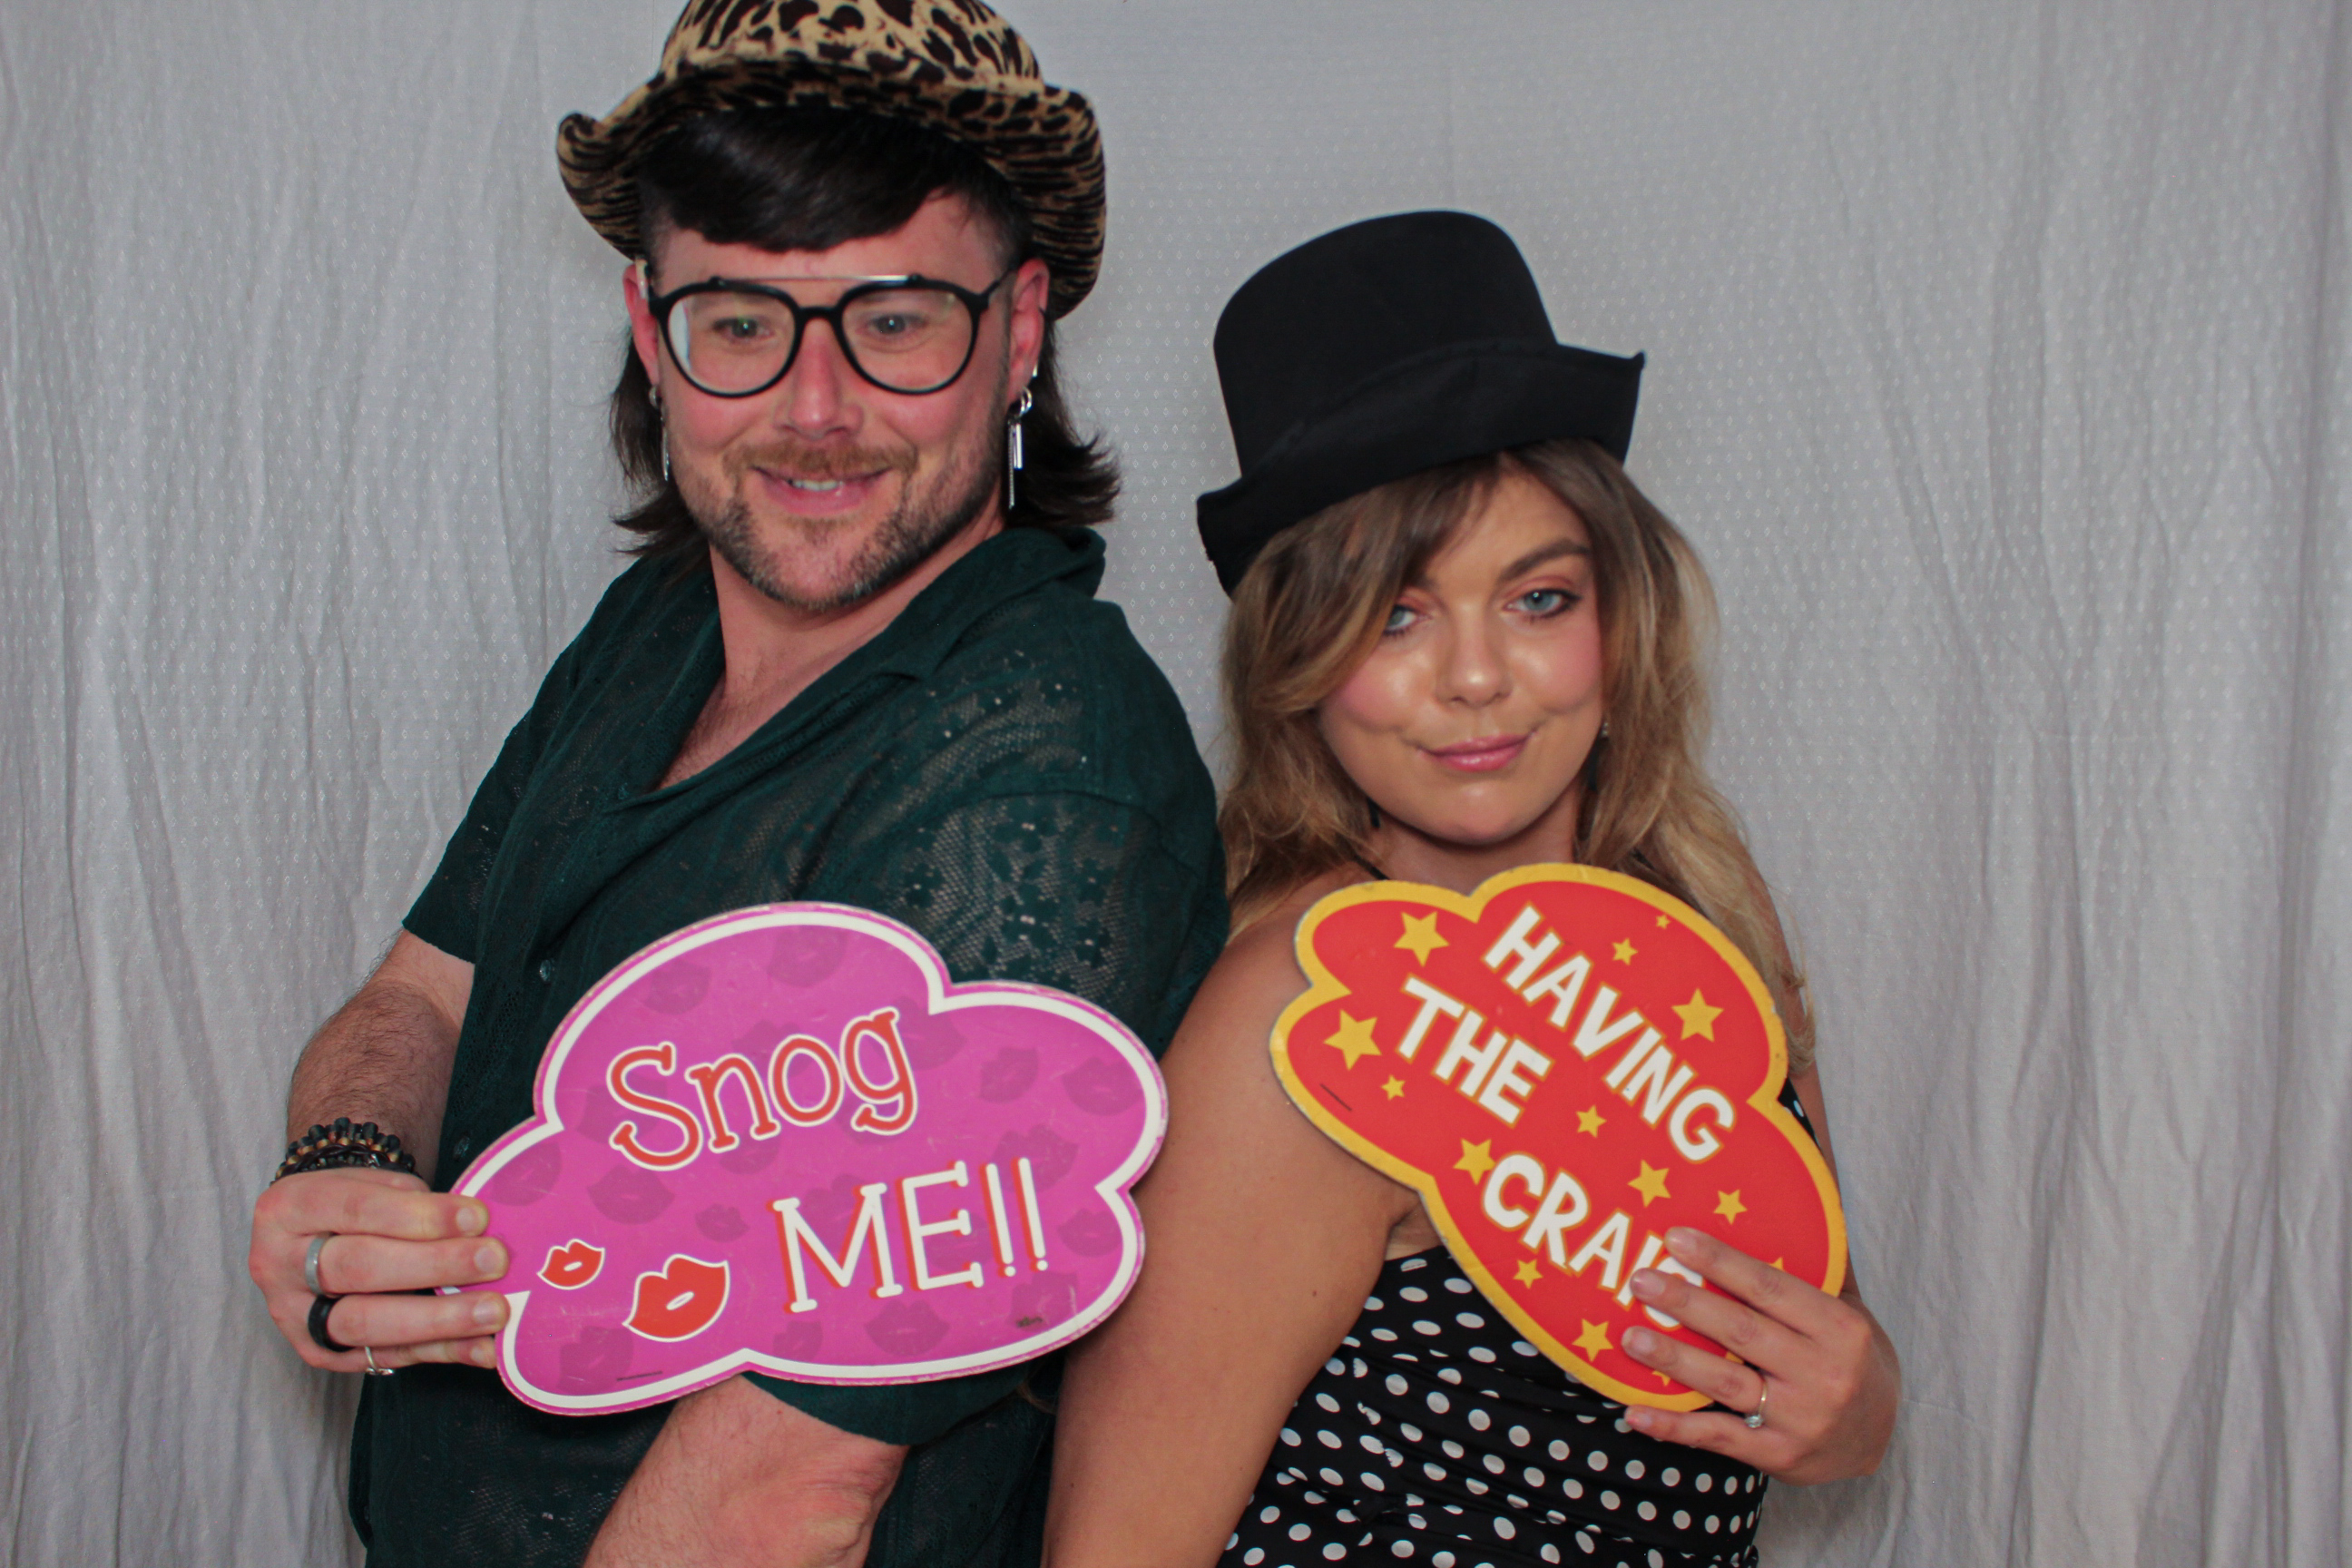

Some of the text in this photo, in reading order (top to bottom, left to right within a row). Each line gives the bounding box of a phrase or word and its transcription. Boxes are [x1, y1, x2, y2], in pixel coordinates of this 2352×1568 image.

[606, 1005, 919, 1171] Snog
[1398, 975, 1553, 1126] THE
[1483, 905, 1736, 1162] HAVING
[768, 1157, 1049, 1315] ME!!
